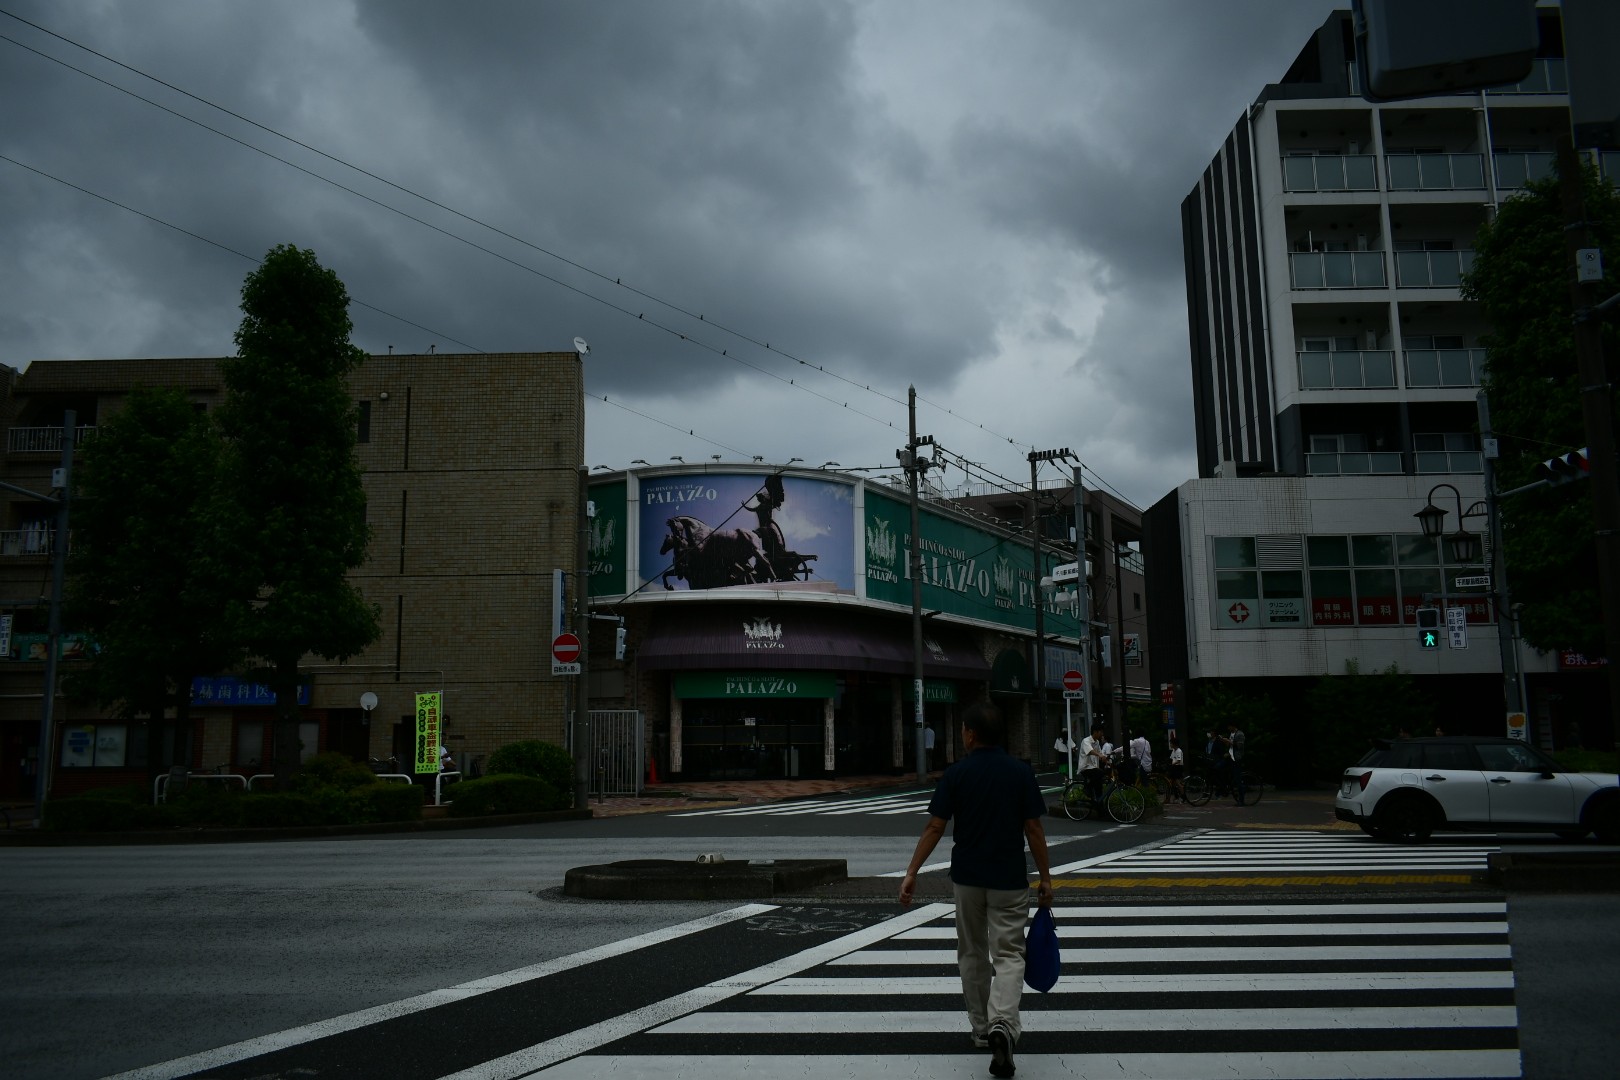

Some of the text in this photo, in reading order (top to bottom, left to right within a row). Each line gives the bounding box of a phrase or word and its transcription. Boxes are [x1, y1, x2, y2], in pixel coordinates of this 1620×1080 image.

[647, 485, 717, 504] PALAZZO
[868, 568, 898, 584] PALAZZO
[1363, 604, 1392, 616] 眼科
[726, 678, 797, 694] PALAZZO
